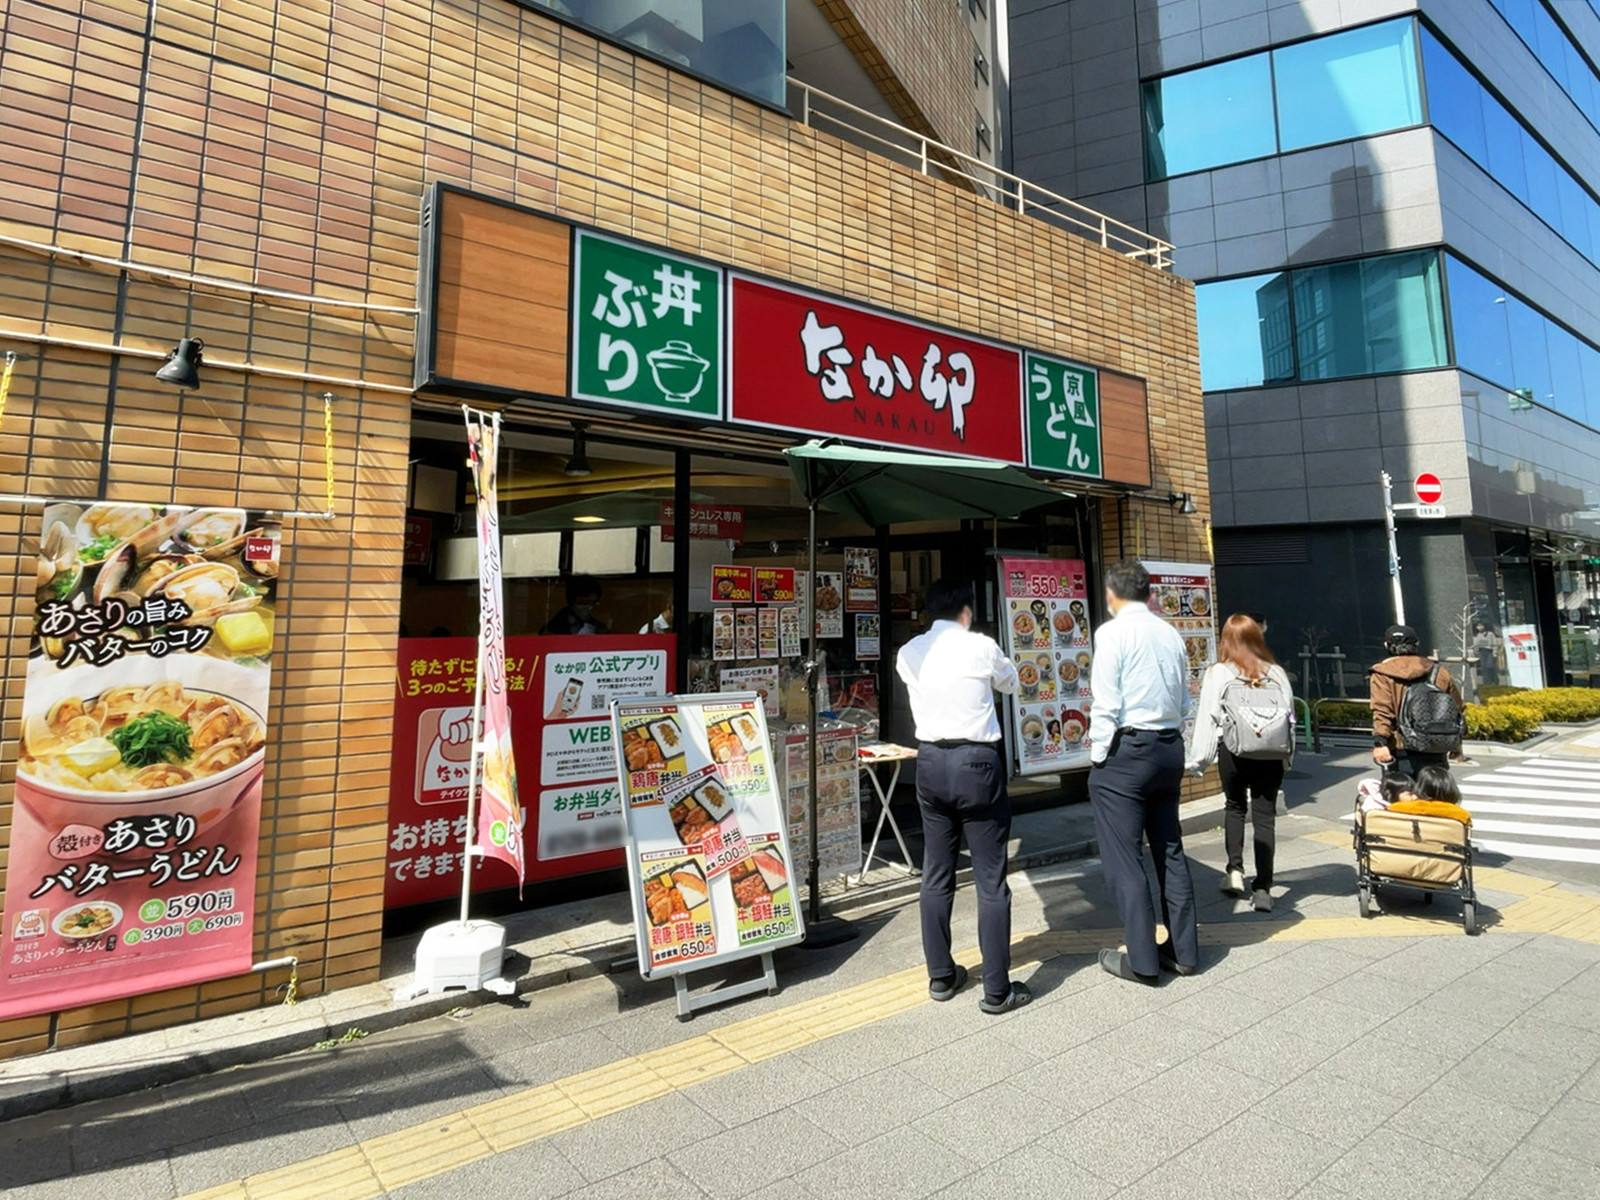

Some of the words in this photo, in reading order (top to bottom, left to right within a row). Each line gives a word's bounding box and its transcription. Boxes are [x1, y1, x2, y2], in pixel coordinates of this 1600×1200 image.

[800, 309, 976, 441] なか卯
[1066, 374, 1088, 422] 京風
[853, 406, 935, 436] NAKAU
[1030, 362, 1091, 471] うどん
[663, 506, 742, 523] キシュレス専用
[40, 600, 189, 636] あさりの旨み
[59, 626, 211, 667] バターのコク
[410, 657, 525, 677] 待たずにる!
[554, 662, 586, 674] なか卯
[588, 654, 660, 674] 公式アプリ
[568, 725, 612, 745] WEB
[56, 833, 102, 855] 殻付き
[104, 814, 196, 853] あさり
[31, 846, 241, 898] バターうどん
[145, 903, 160, 919] 並
[166, 891, 233, 919] 590円
[142, 925, 183, 942] 390円
[205, 914, 242, 931] 690円
[11, 940, 106, 965] あさりバターうどん
